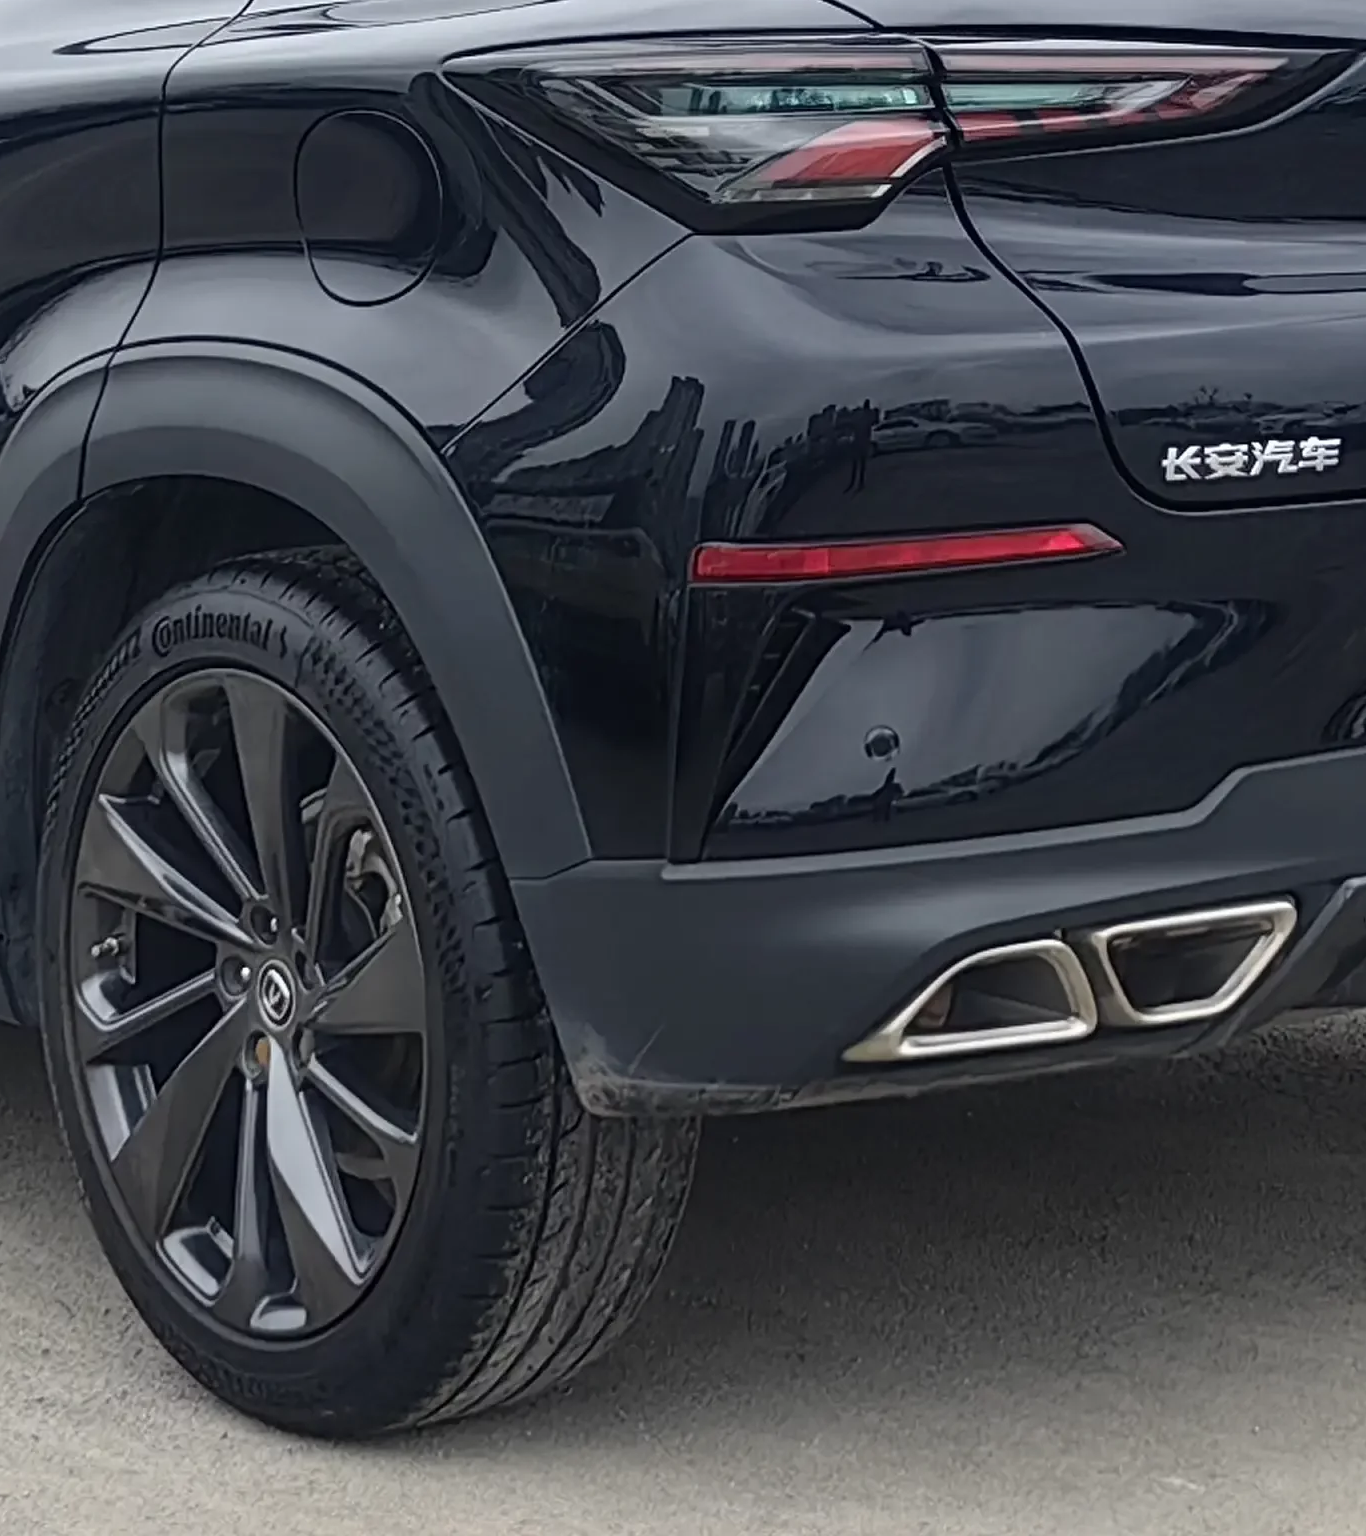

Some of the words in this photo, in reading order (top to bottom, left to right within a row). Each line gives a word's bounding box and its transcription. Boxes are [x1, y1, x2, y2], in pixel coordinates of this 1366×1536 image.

[1161, 436, 1342, 481] 长安汽车
[151, 603, 273, 658] Continental
